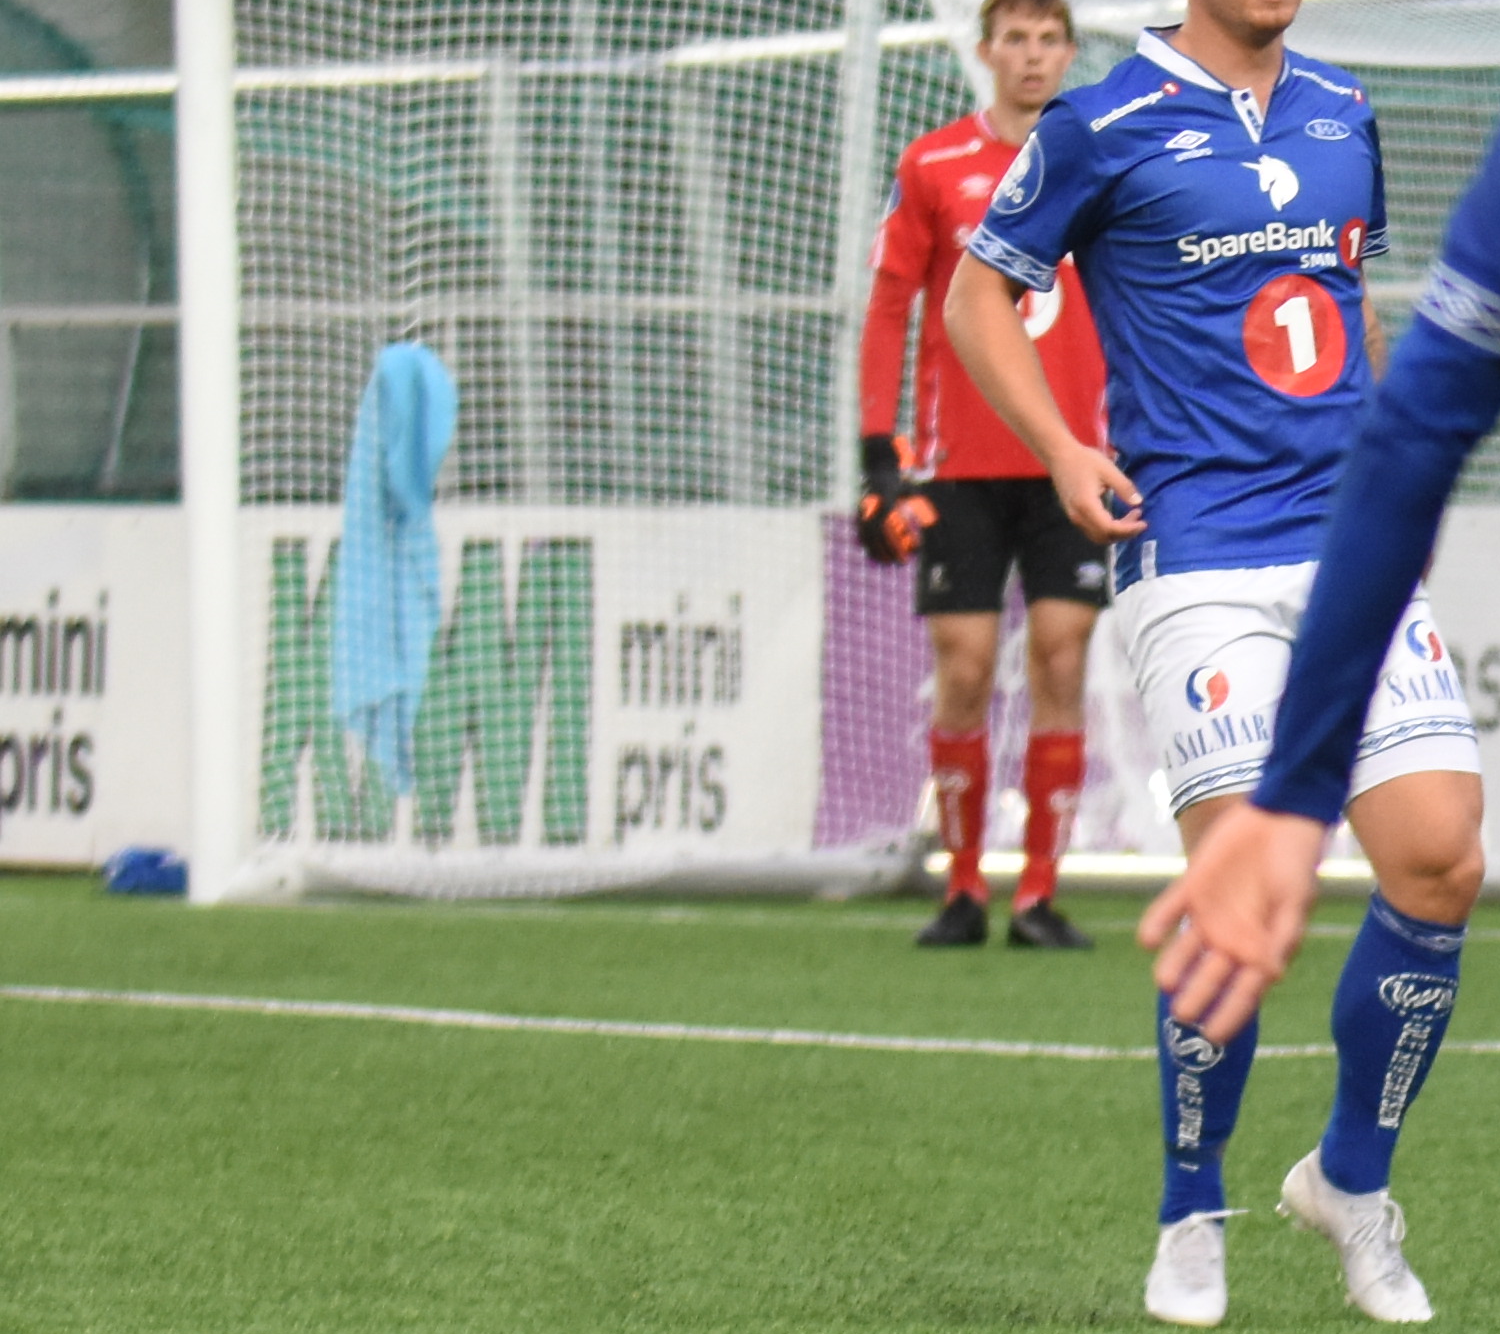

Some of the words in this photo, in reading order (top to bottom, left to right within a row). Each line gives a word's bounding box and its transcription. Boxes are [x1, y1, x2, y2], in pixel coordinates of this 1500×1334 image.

[1177, 219, 1335, 265] SpareBank
[1349, 227, 1361, 260] 1
[1299, 253, 1338, 269] SMN
[1273, 295, 1317, 374] 1
[620, 593, 743, 706] mini
[616, 720, 727, 842] pris
